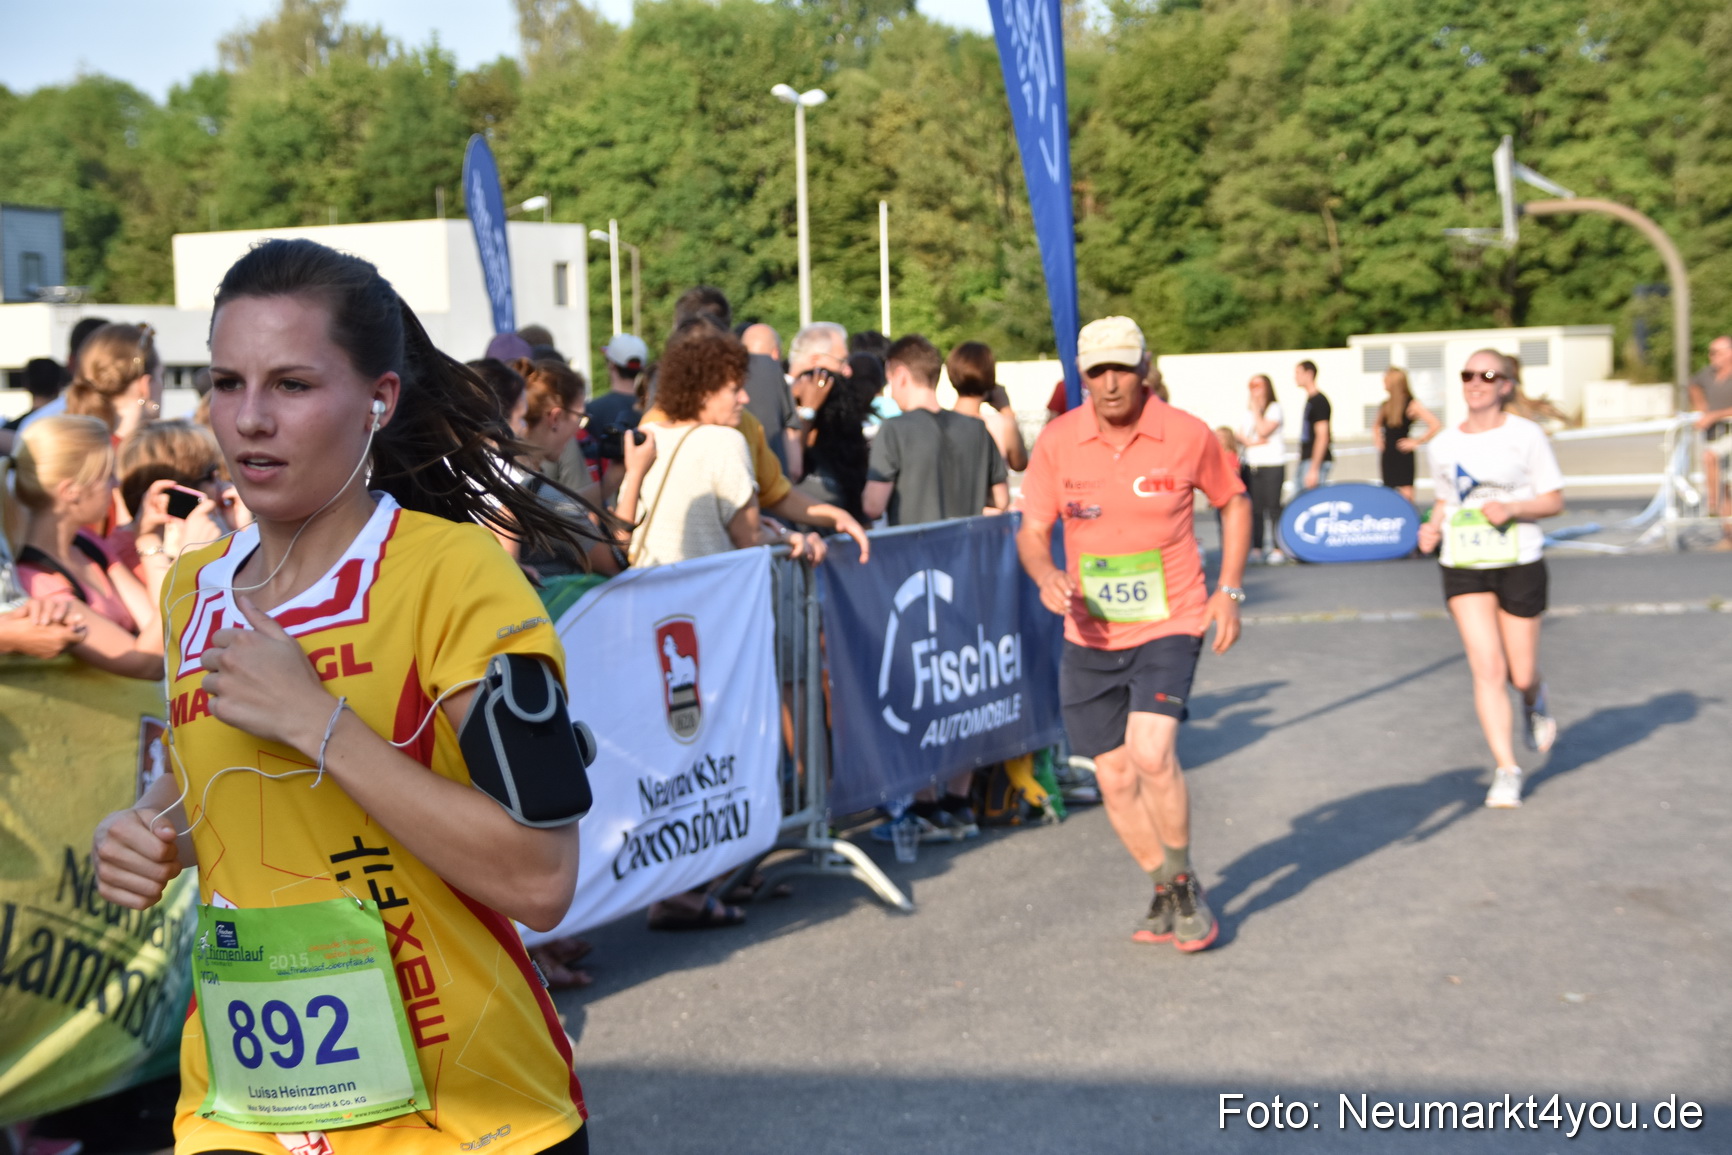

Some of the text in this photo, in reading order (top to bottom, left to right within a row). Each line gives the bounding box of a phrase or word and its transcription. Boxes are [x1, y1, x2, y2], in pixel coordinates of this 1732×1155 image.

[1315, 514, 1406, 538] Fischer
[1098, 581, 1148, 603] 456
[171, 687, 210, 728] MA
[919, 692, 1022, 750] AUTOMOBILE
[268, 952, 309, 970] 2015
[227, 994, 361, 1070] 892
[248, 1079, 357, 1099] Luisa Heinzmann
[272, 1102, 307, 1112] Bauservice
[309, 1101, 331, 1110] GmbH
[340, 1098, 353, 1106] Co.
